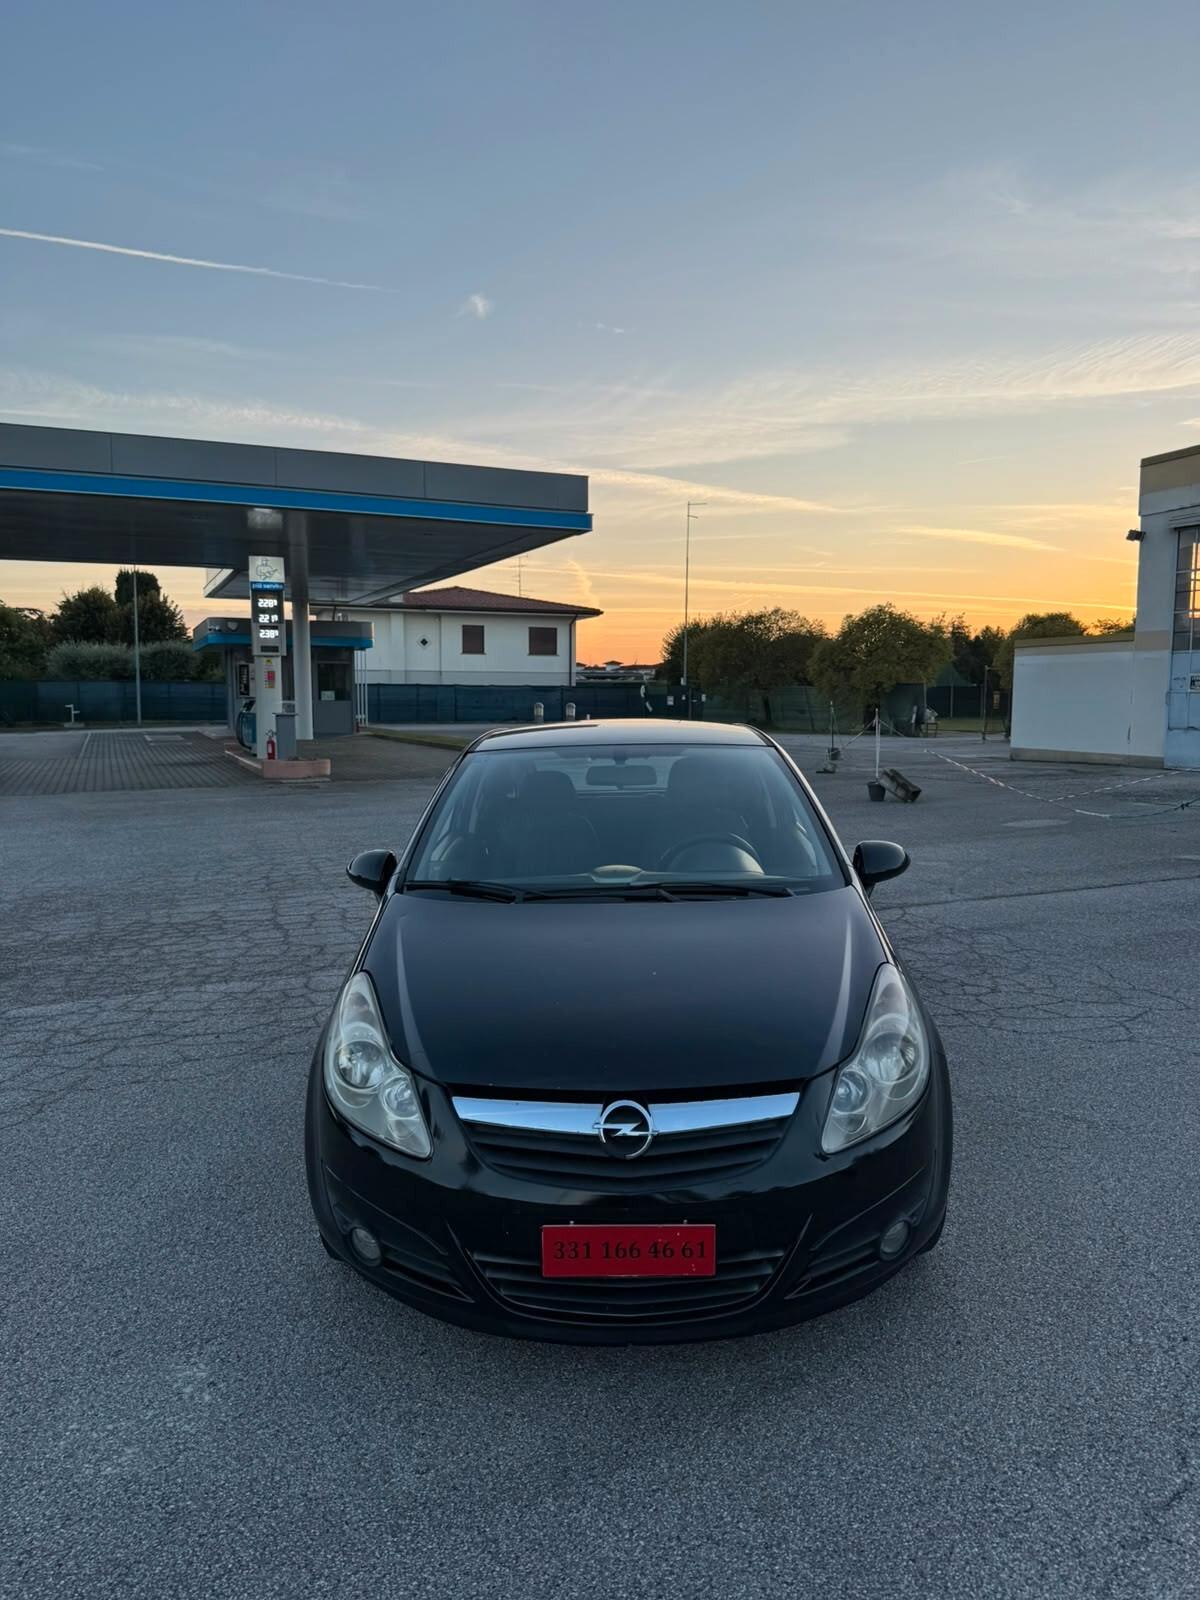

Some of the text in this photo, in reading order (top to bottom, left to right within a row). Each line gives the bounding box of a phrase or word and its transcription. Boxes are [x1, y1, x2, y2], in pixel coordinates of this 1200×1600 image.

[553, 1239, 706, 1259] 331 166 46 61
